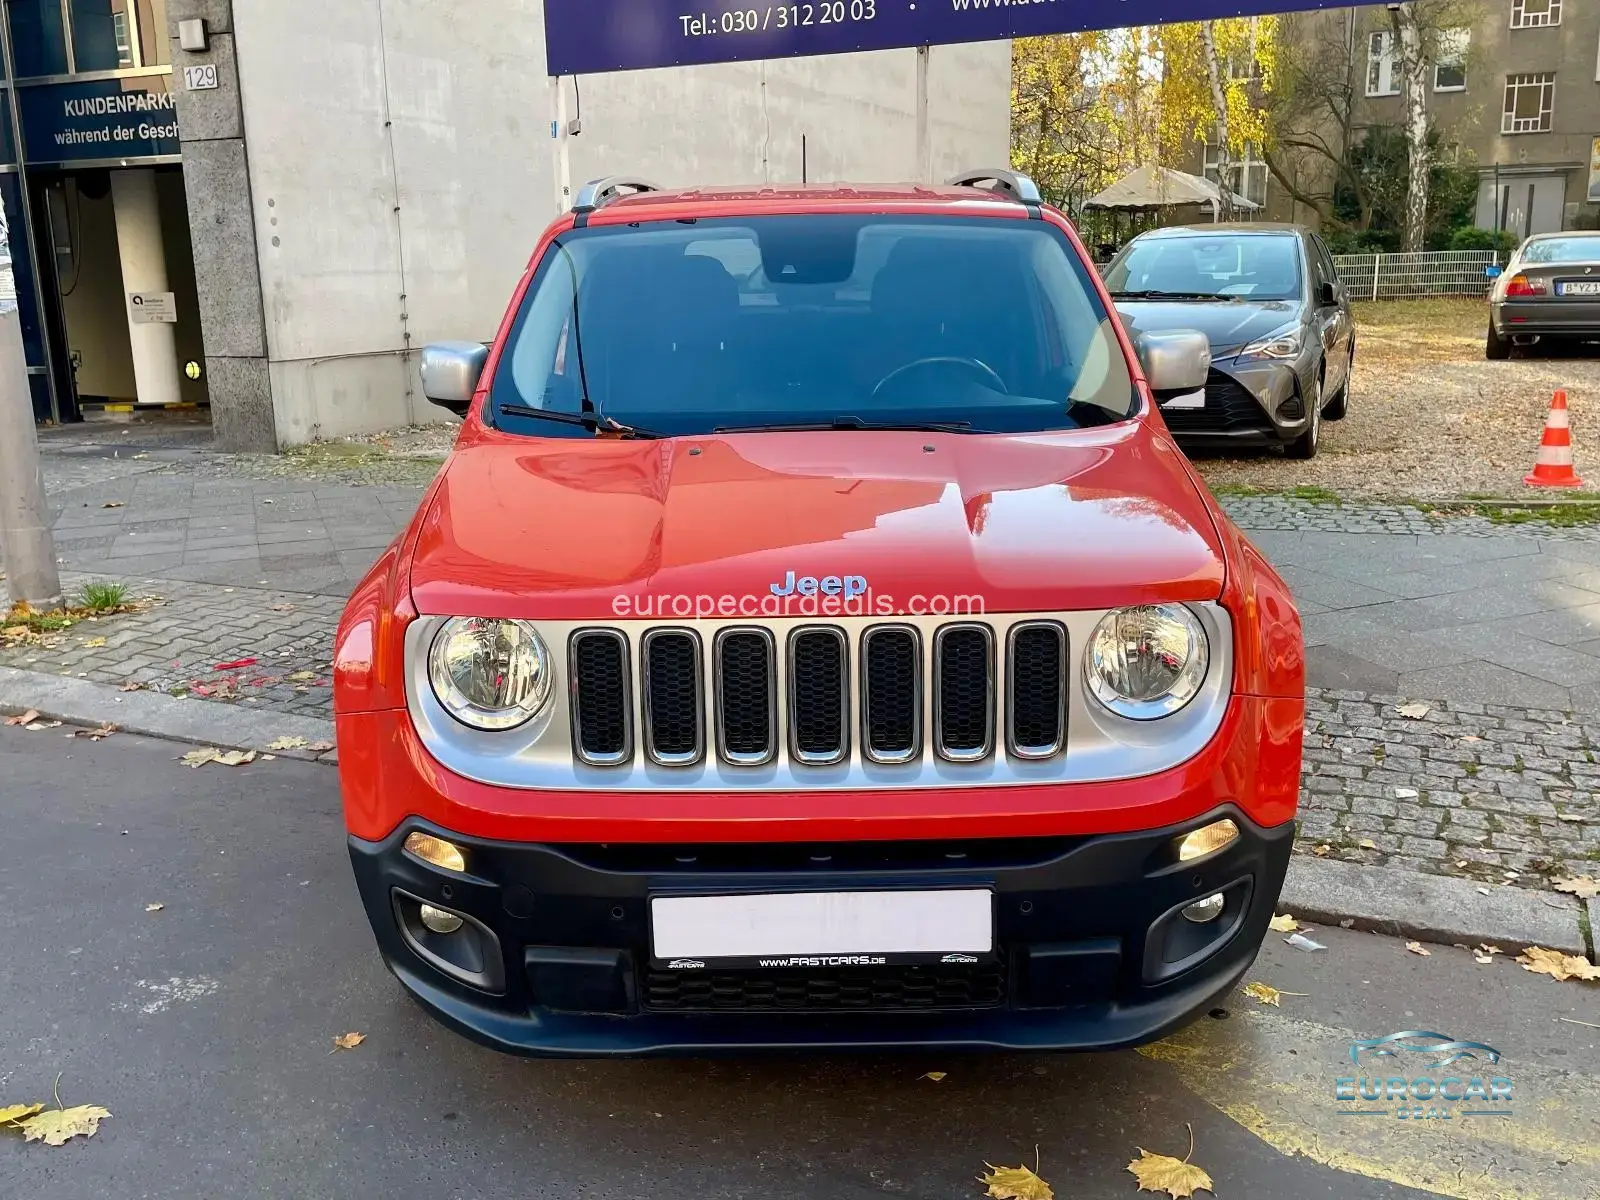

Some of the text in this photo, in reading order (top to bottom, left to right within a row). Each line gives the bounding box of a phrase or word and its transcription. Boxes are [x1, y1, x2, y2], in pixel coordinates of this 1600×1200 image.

[679, 0, 876, 36] Tel.: 030 / 312 20 03
[186, 66, 215, 88] 129
[54, 126, 110, 145] während
[113, 125, 135, 141] der
[770, 571, 868, 600] Jeep
[759, 956, 886, 967] www.FASTCARS.DE
